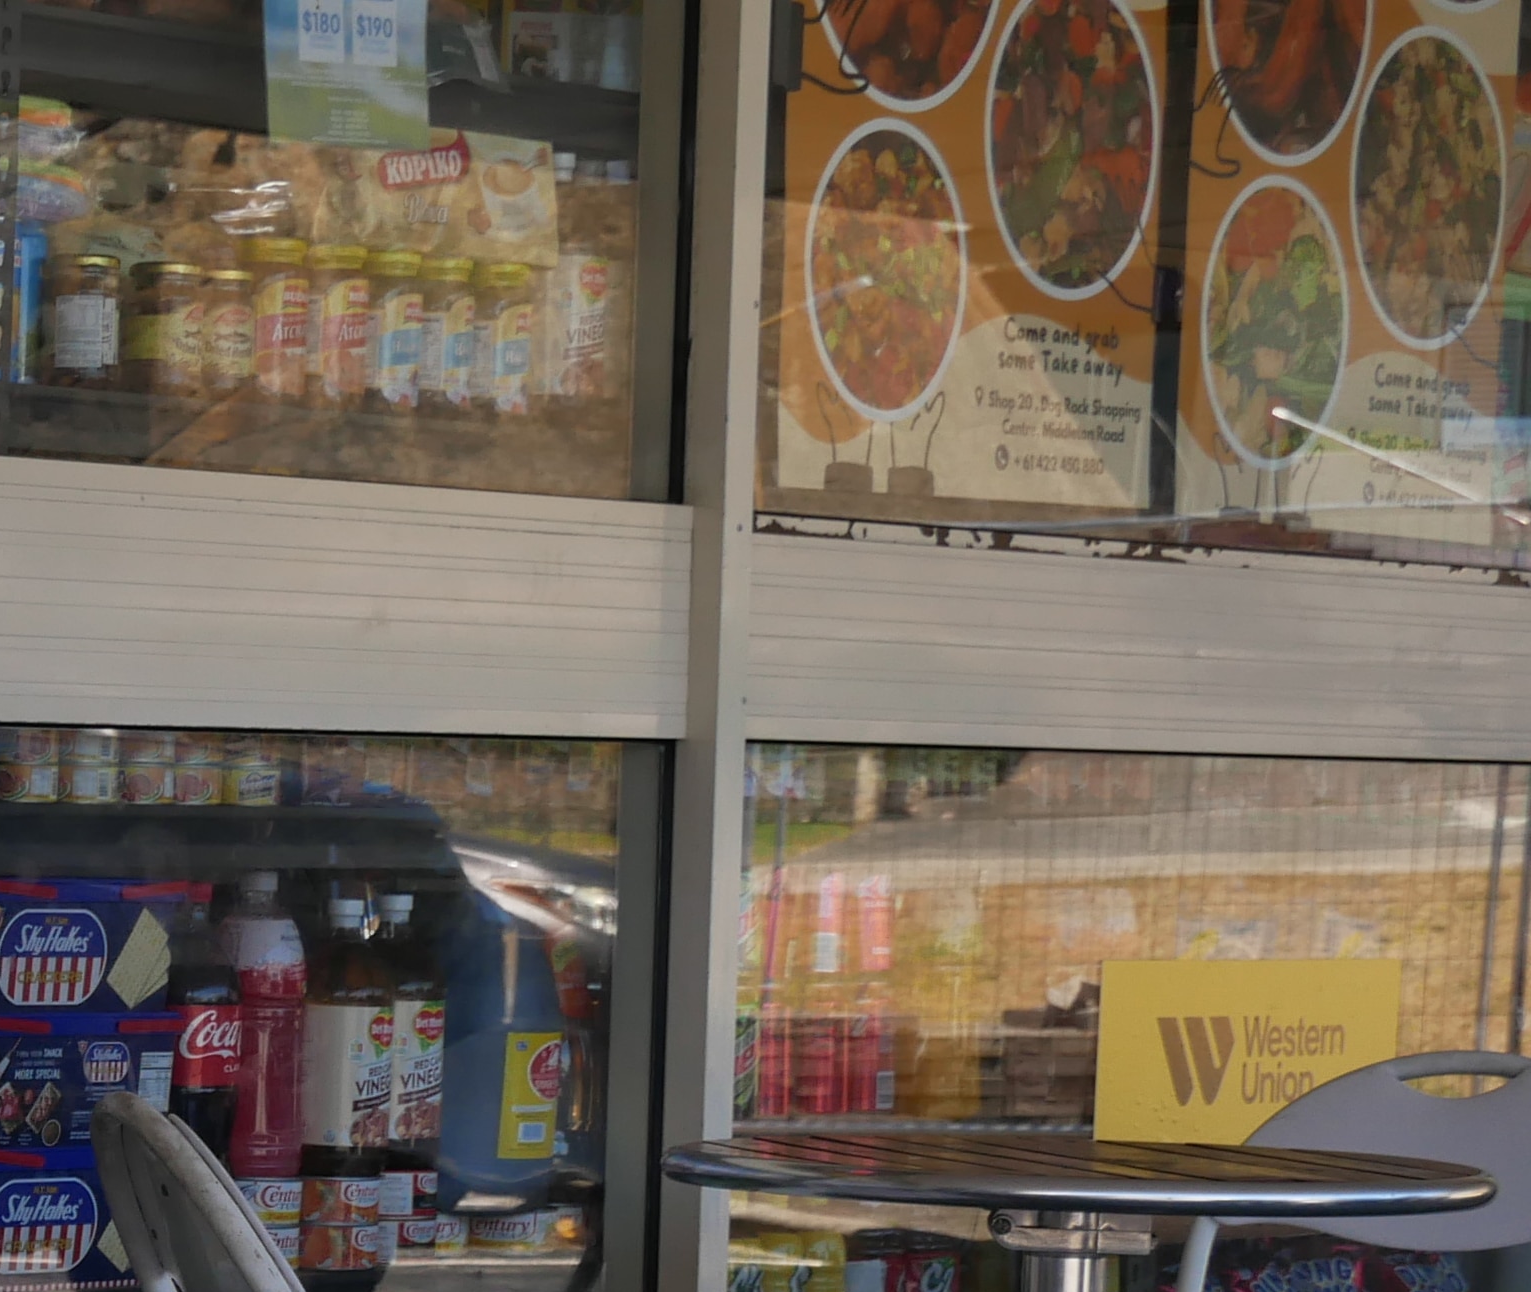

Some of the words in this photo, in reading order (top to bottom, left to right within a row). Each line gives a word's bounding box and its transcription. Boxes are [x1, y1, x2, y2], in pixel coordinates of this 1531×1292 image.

[302, 11, 340, 34] $180
[357, 16, 393, 38] $190
[385, 150, 462, 185] KOPIKO
[1004, 317, 1046, 343] Come
[1052, 325, 1080, 346] and
[1086, 325, 1119, 353] grab
[998, 351, 1036, 370] some
[1042, 350, 1078, 374] Take
[1083, 361, 1123, 387] away
[1374, 362, 1412, 388] Come
[1416, 373, 1438, 393] and
[988, 390, 1015, 413] Shop
[1064, 397, 1089, 415] Rock
[1092, 400, 1142, 423] Shopping
[1368, 396, 1401, 414] some
[1407, 396, 1438, 418] Take
[1097, 424, 1125, 443] Road
[17, 971, 83, 984] CRACKERS
[1243, 1015, 1346, 1057] Western
[356, 1075, 390, 1096] VINEG
[401, 1068, 441, 1089] VINEG
[1240, 1062, 1316, 1105] Union
[5, 1238, 73, 1252] CRACKERS
